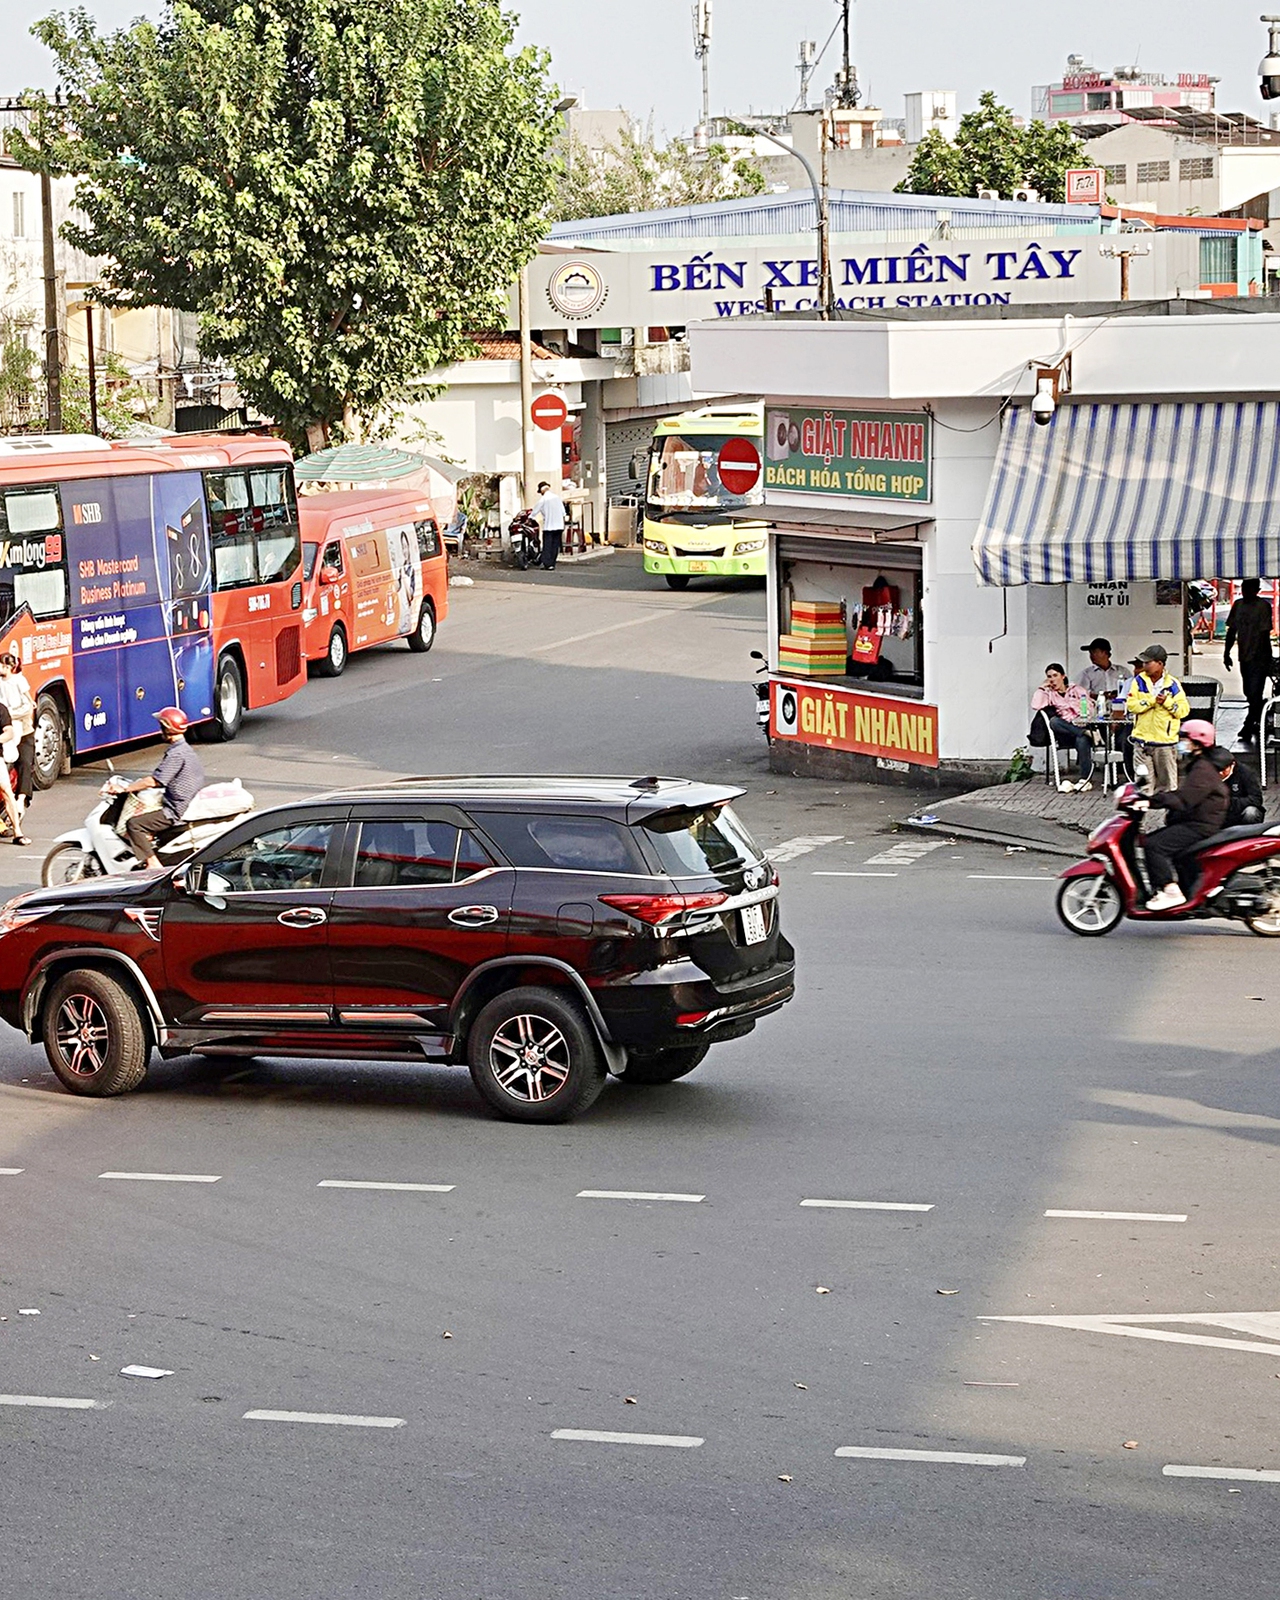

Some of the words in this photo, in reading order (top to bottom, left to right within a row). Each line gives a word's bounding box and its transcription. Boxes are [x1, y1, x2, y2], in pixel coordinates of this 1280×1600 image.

[650, 251, 748, 291] BẾN
[762, 259, 820, 288] XE
[841, 242, 971, 286] MIỀN
[985, 242, 1082, 281] TÂY
[801, 411, 848, 465] GIẶT
[851, 420, 925, 463] NHANH
[766, 464, 806, 486] BÁCH
[810, 467, 841, 489] HÓA
[845, 466, 886, 492] TỔNG
[891, 475, 924, 498] HỢP
[81, 503, 102, 524] SHB
[78, 560, 95, 578] SHB
[97, 555, 139, 576] Mastercard
[80, 585, 112, 605] Business
[113, 581, 146, 599] Platinum
[1087, 593, 1113, 608] GIẶT
[1117, 591, 1130, 606] ỦI
[801, 692, 849, 745] GIẶT
[854, 705, 933, 755] NHANH
